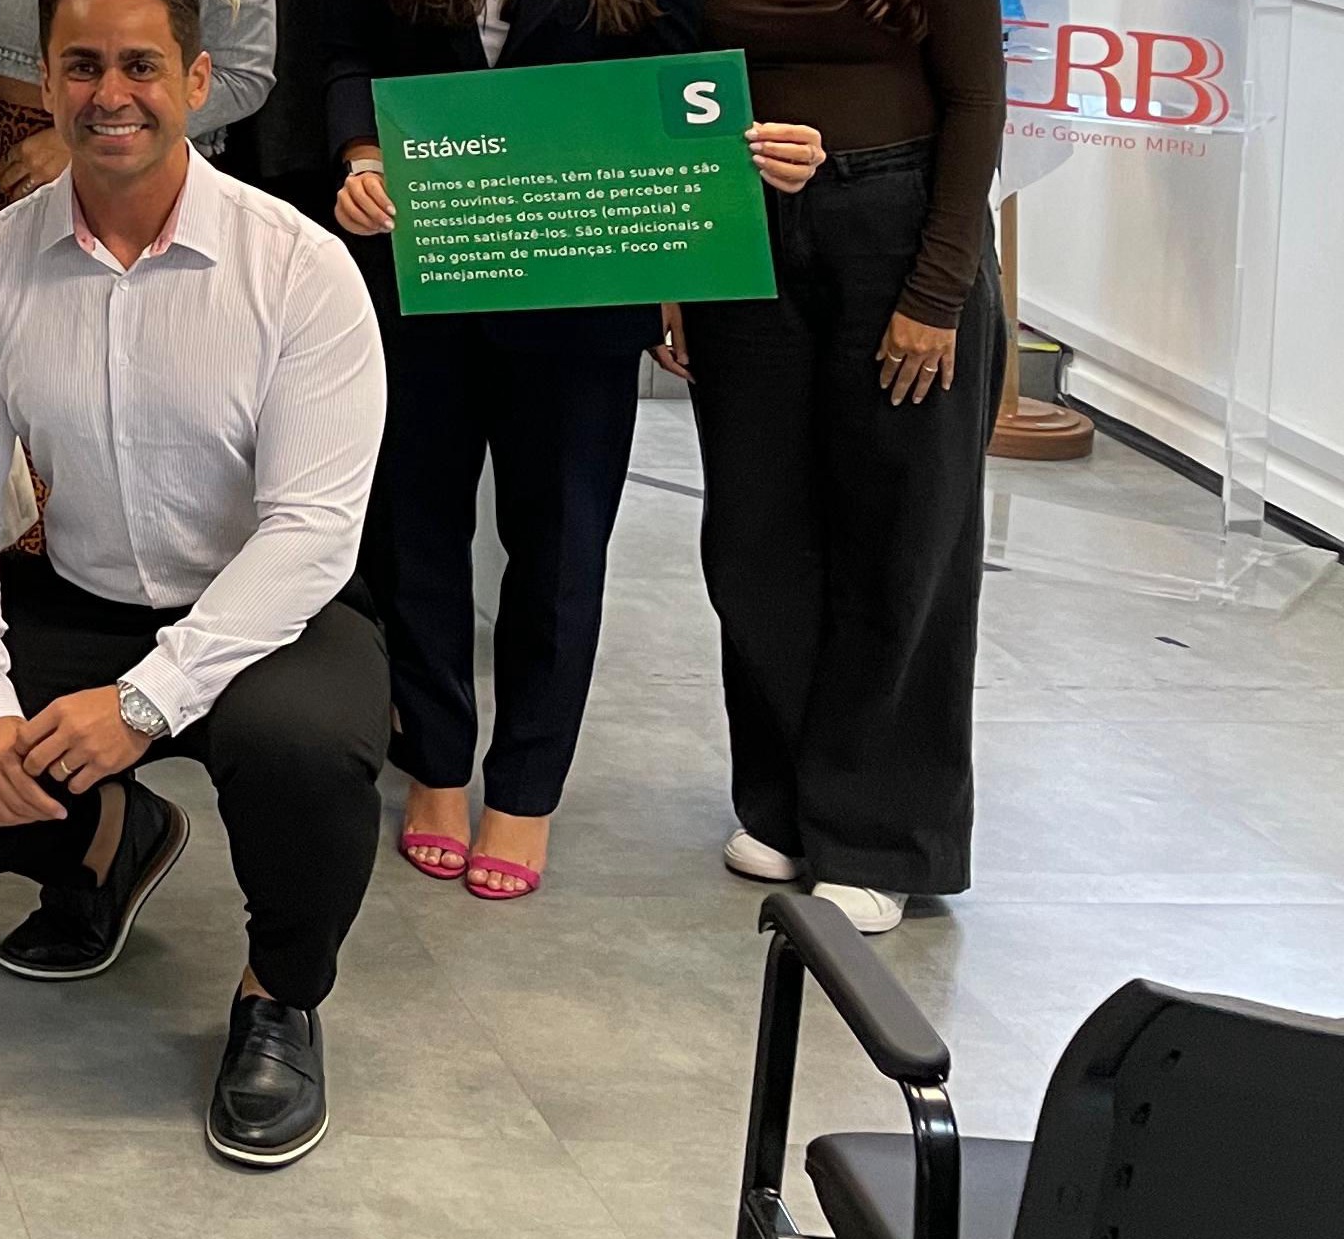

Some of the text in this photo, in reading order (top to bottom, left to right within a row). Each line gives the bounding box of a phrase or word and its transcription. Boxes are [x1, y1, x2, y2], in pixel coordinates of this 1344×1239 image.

[683, 80, 721, 125] S
[403, 134, 507, 160] Estáveis:
[1022, 122, 1045, 138] de
[1053, 125, 1136, 150] Governo
[1146, 136, 1207, 158] MPRJ
[408, 163, 719, 191] Calmos e pacientes, têm fala suave e são
[411, 184, 701, 209] bons ouvintes. Gostam de perceber as
[414, 202, 690, 227] necessidades dos outros (empatia) e
[416, 235, 469, 245] tentam
[576, 226, 602, 236] São
[608, 220, 699, 235] tradicionais
[704, 221, 713, 229] e
[419, 241, 687, 264] não gostam de mudanças. Foco em
